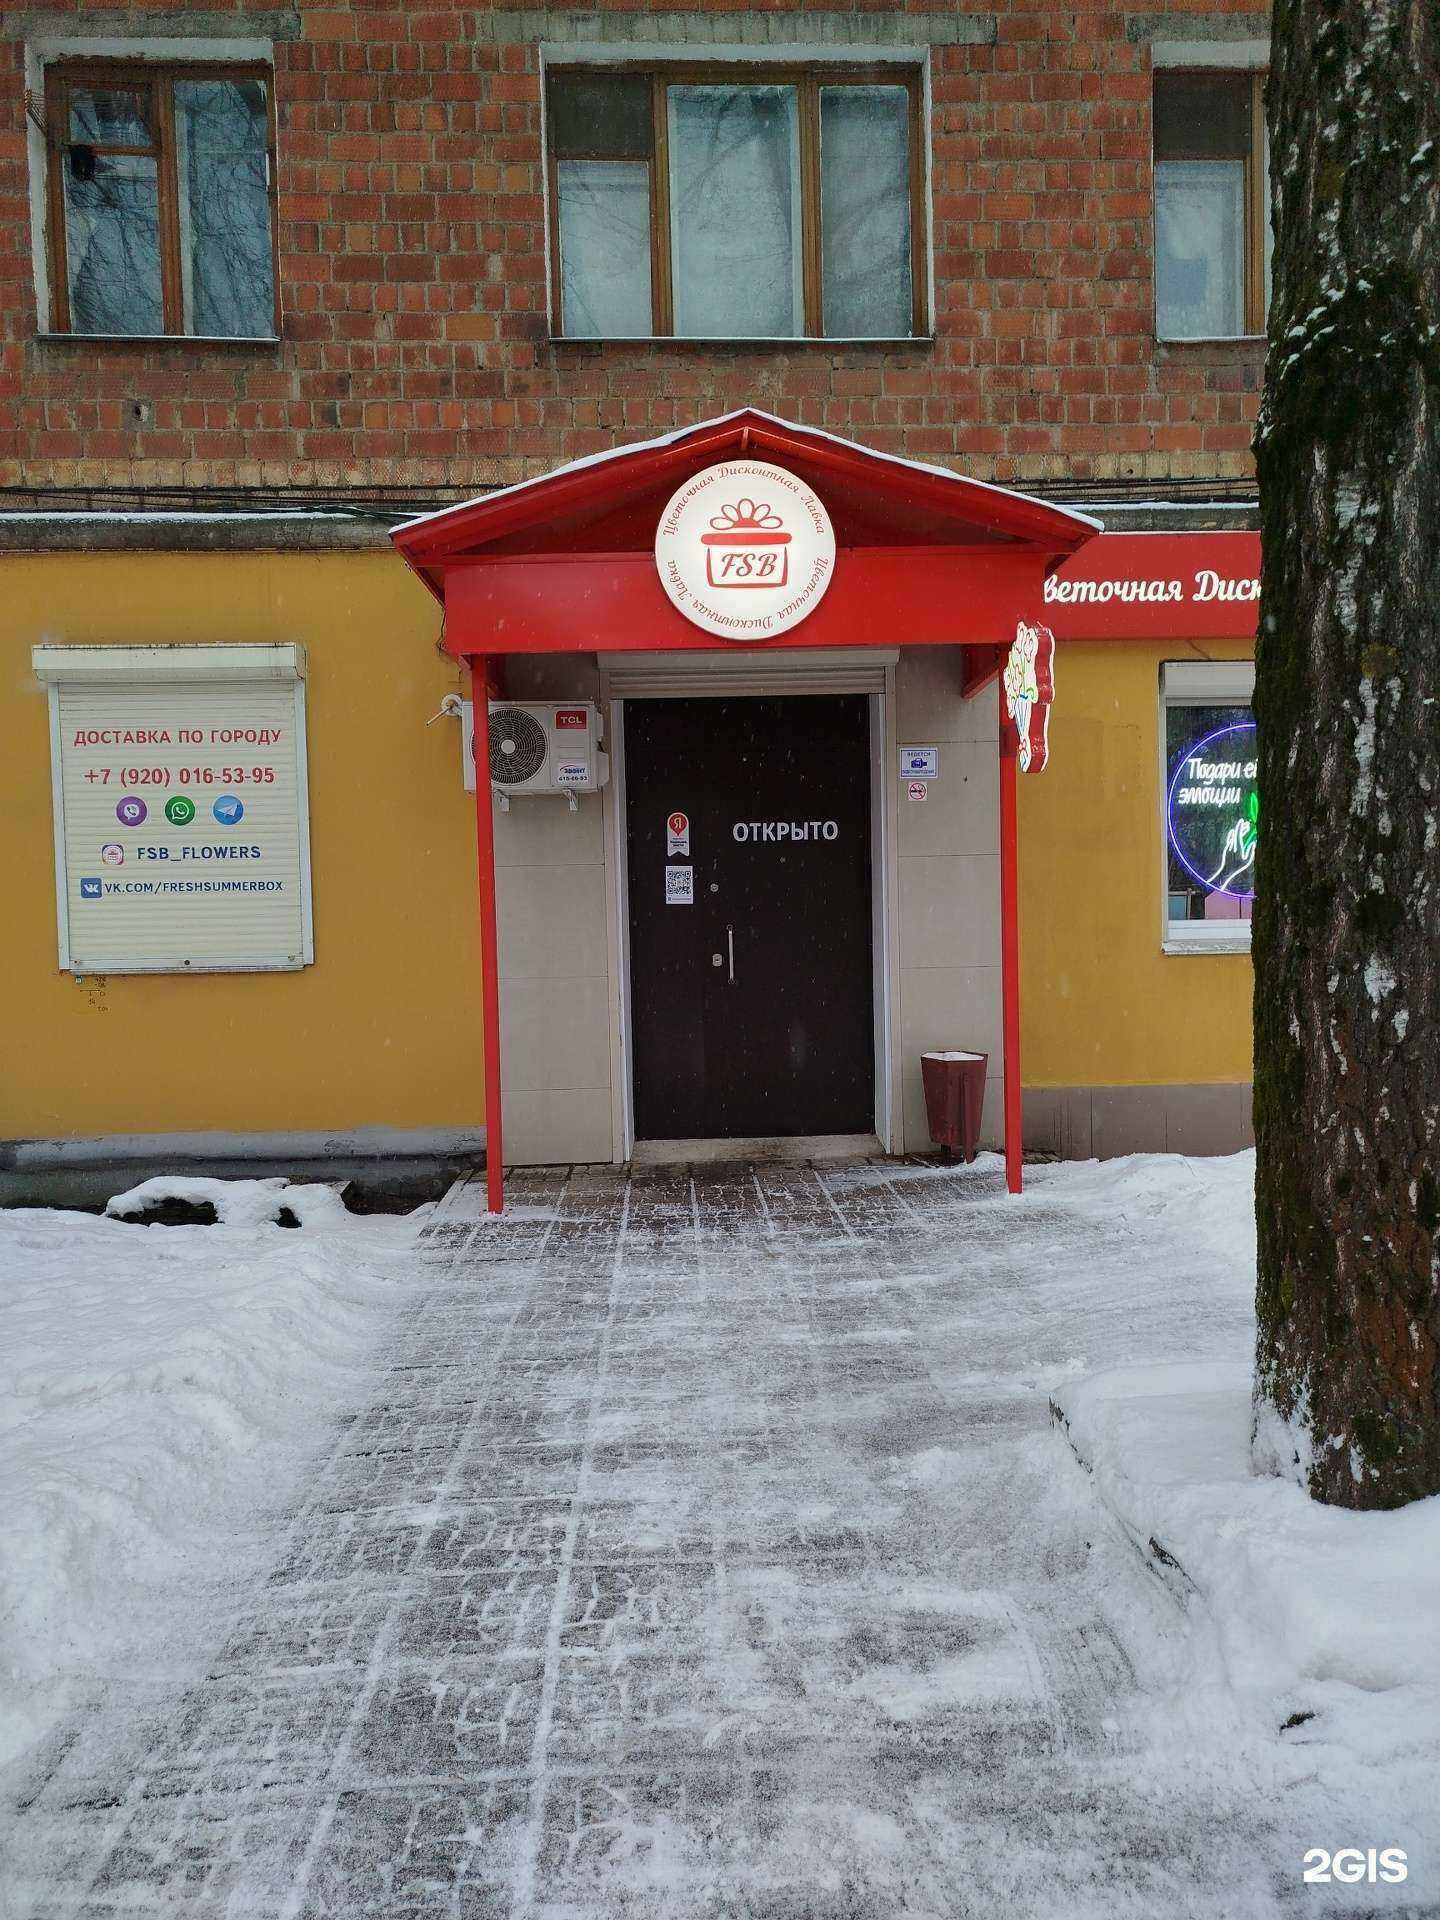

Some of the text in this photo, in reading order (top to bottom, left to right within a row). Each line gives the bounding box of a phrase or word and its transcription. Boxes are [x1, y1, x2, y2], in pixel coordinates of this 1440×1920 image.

[662, 465, 825, 536] Цветочная Дисконтная Лавка
[721, 553, 777, 577] FSB
[667, 556, 828, 630] Цветочная Дисконтная Лавка
[1043, 570, 1262, 603] веточная Диск
[560, 716, 583, 724] TCL
[74, 729, 281, 747] ДОСТАВКА ПО ГОРОДУ
[84, 767, 274, 787] +7 (920) 016-53-95
[1187, 757, 1242, 785] Подари
[1178, 786, 1242, 808] эмоции
[732, 820, 839, 842] ОТКРЫТО
[137, 846, 261, 862] FSB_FLOWERS
[104, 881, 283, 894] VK.COM/FRESHSUMMERBOX
